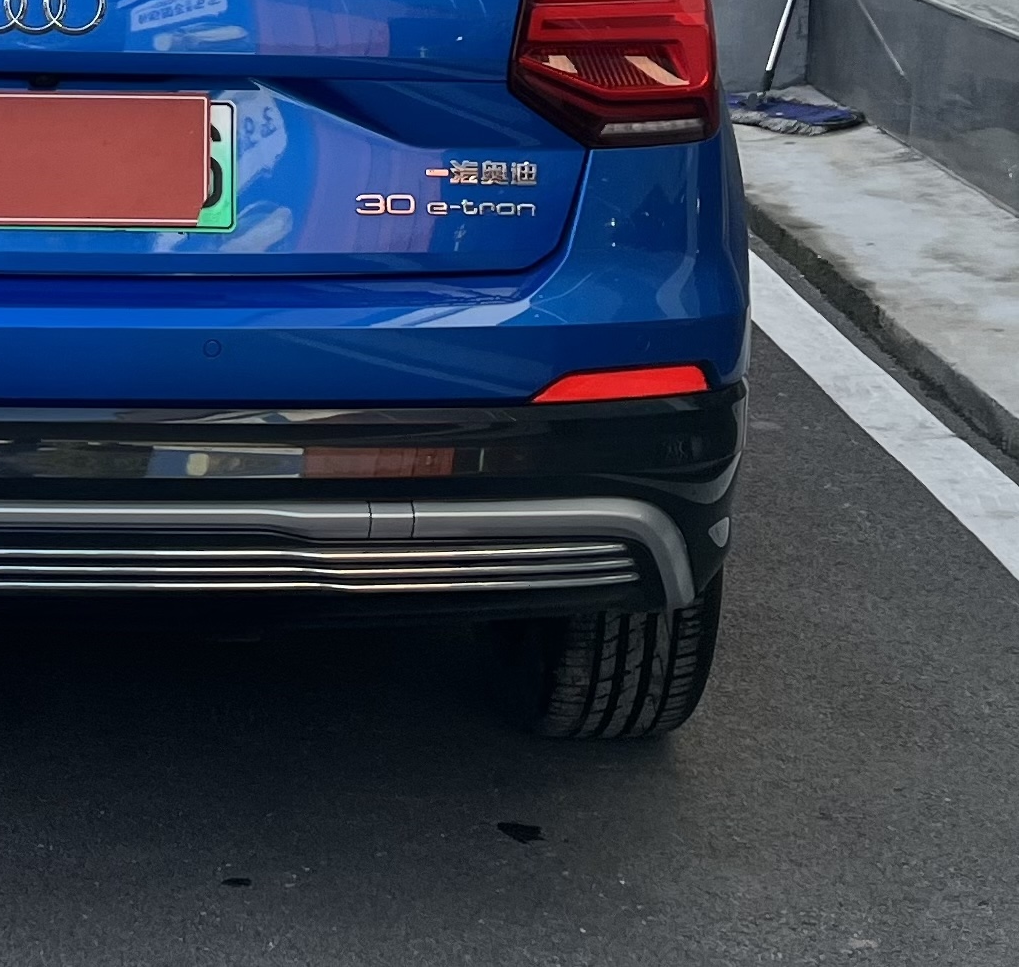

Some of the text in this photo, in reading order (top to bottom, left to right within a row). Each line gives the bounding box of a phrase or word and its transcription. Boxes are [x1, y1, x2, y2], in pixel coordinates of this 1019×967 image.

[425, 160, 537, 185] 一汽奥迪
[356, 194, 536, 216] 30 e-tron
